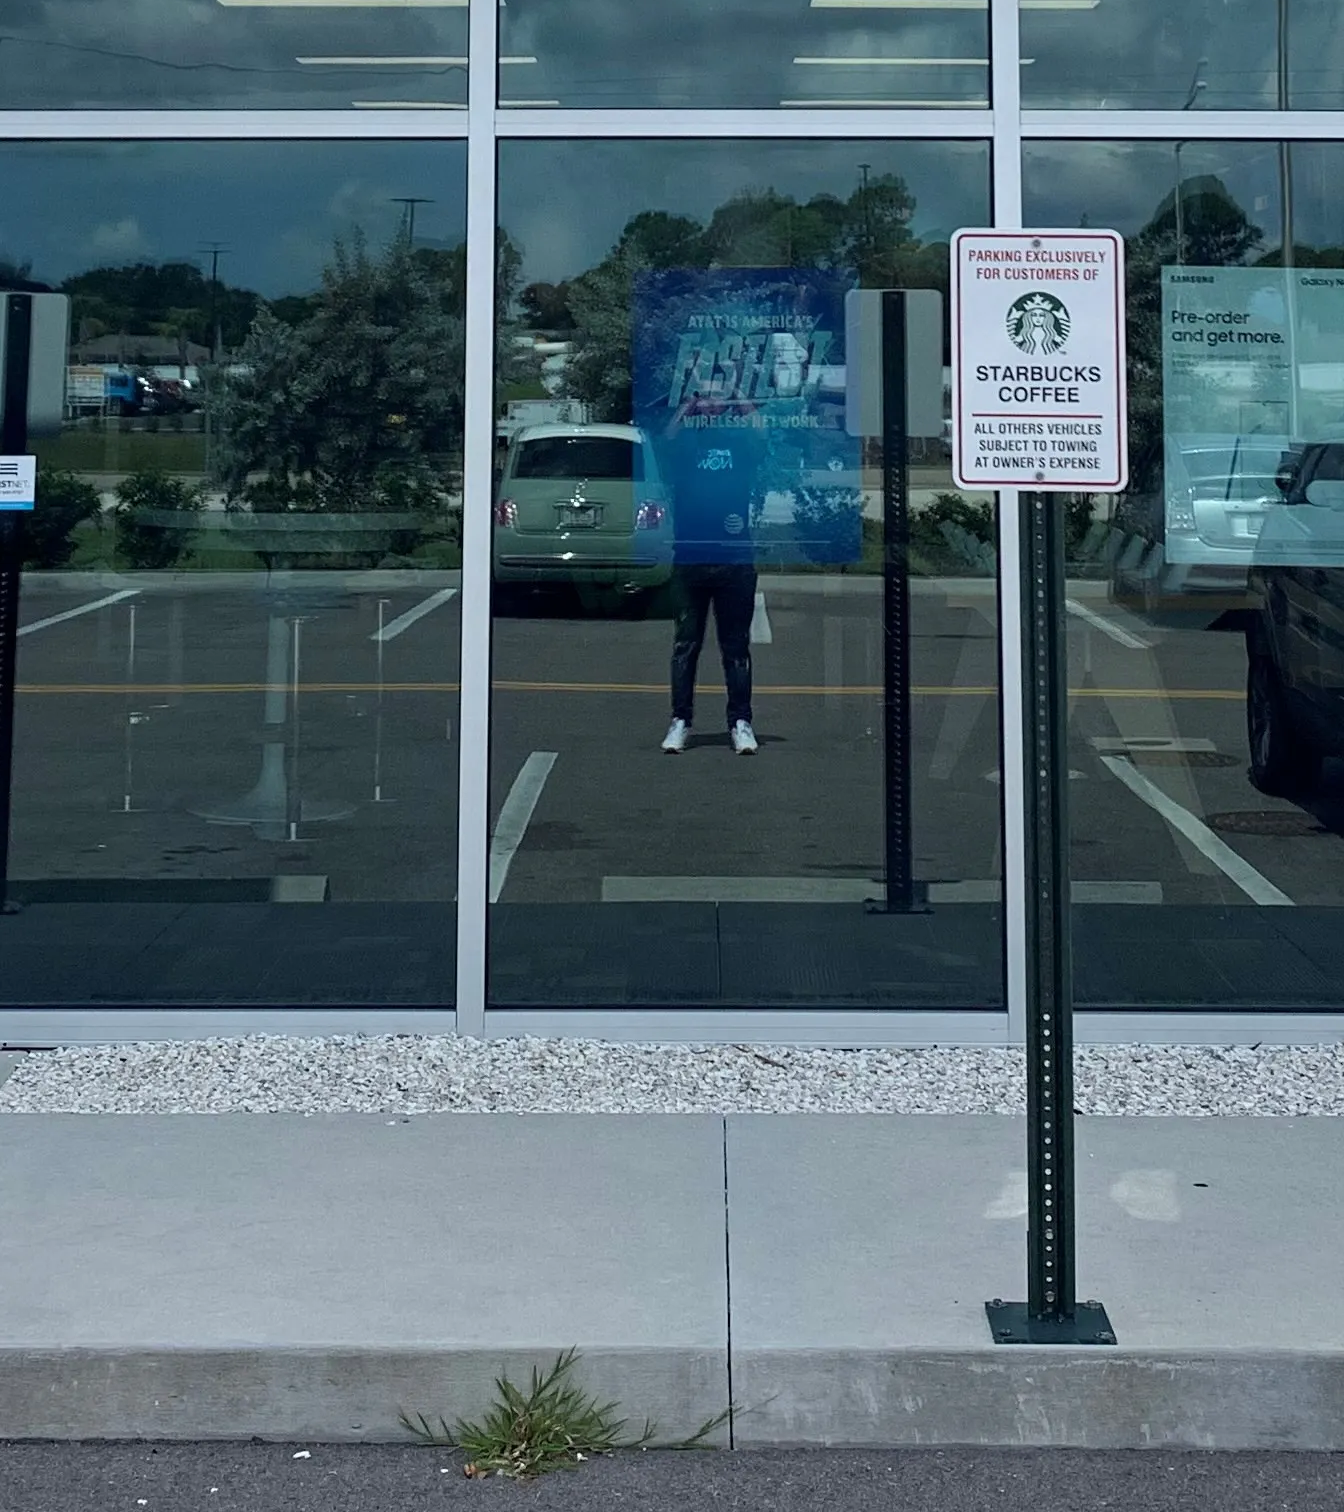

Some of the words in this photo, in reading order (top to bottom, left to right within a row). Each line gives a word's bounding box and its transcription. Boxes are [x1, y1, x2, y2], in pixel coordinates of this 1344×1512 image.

[968, 249, 1022, 262] PARKING
[1025, 250, 1106, 264] EXCLUSIVELY
[976, 267, 1001, 280] FOR
[1004, 267, 1079, 281] CUSTOMERS
[1083, 268, 1099, 281] OF
[1171, 309, 1251, 325] Pre-order
[1171, 328, 1204, 342] and
[1206, 329, 1235, 347] get
[1237, 332, 1285, 344] more.
[976, 365, 1101, 383] STARBUCKS
[998, 386, 1080, 403] COFFEE
[683, 415, 749, 429] WIRELESS
[974, 423, 995, 435] ALL
[998, 422, 1044, 435] OTHERS
[1047, 423, 1102, 436] VEHICLES
[978, 439, 1029, 452] SUBJECT
[1032, 440, 1047, 452] TO
[1050, 440, 1097, 452] TOWING
[974, 456, 989, 468] AT
[992, 456, 1046, 469] OWNER'S
[1049, 457, 1100, 470] EXPENSE
